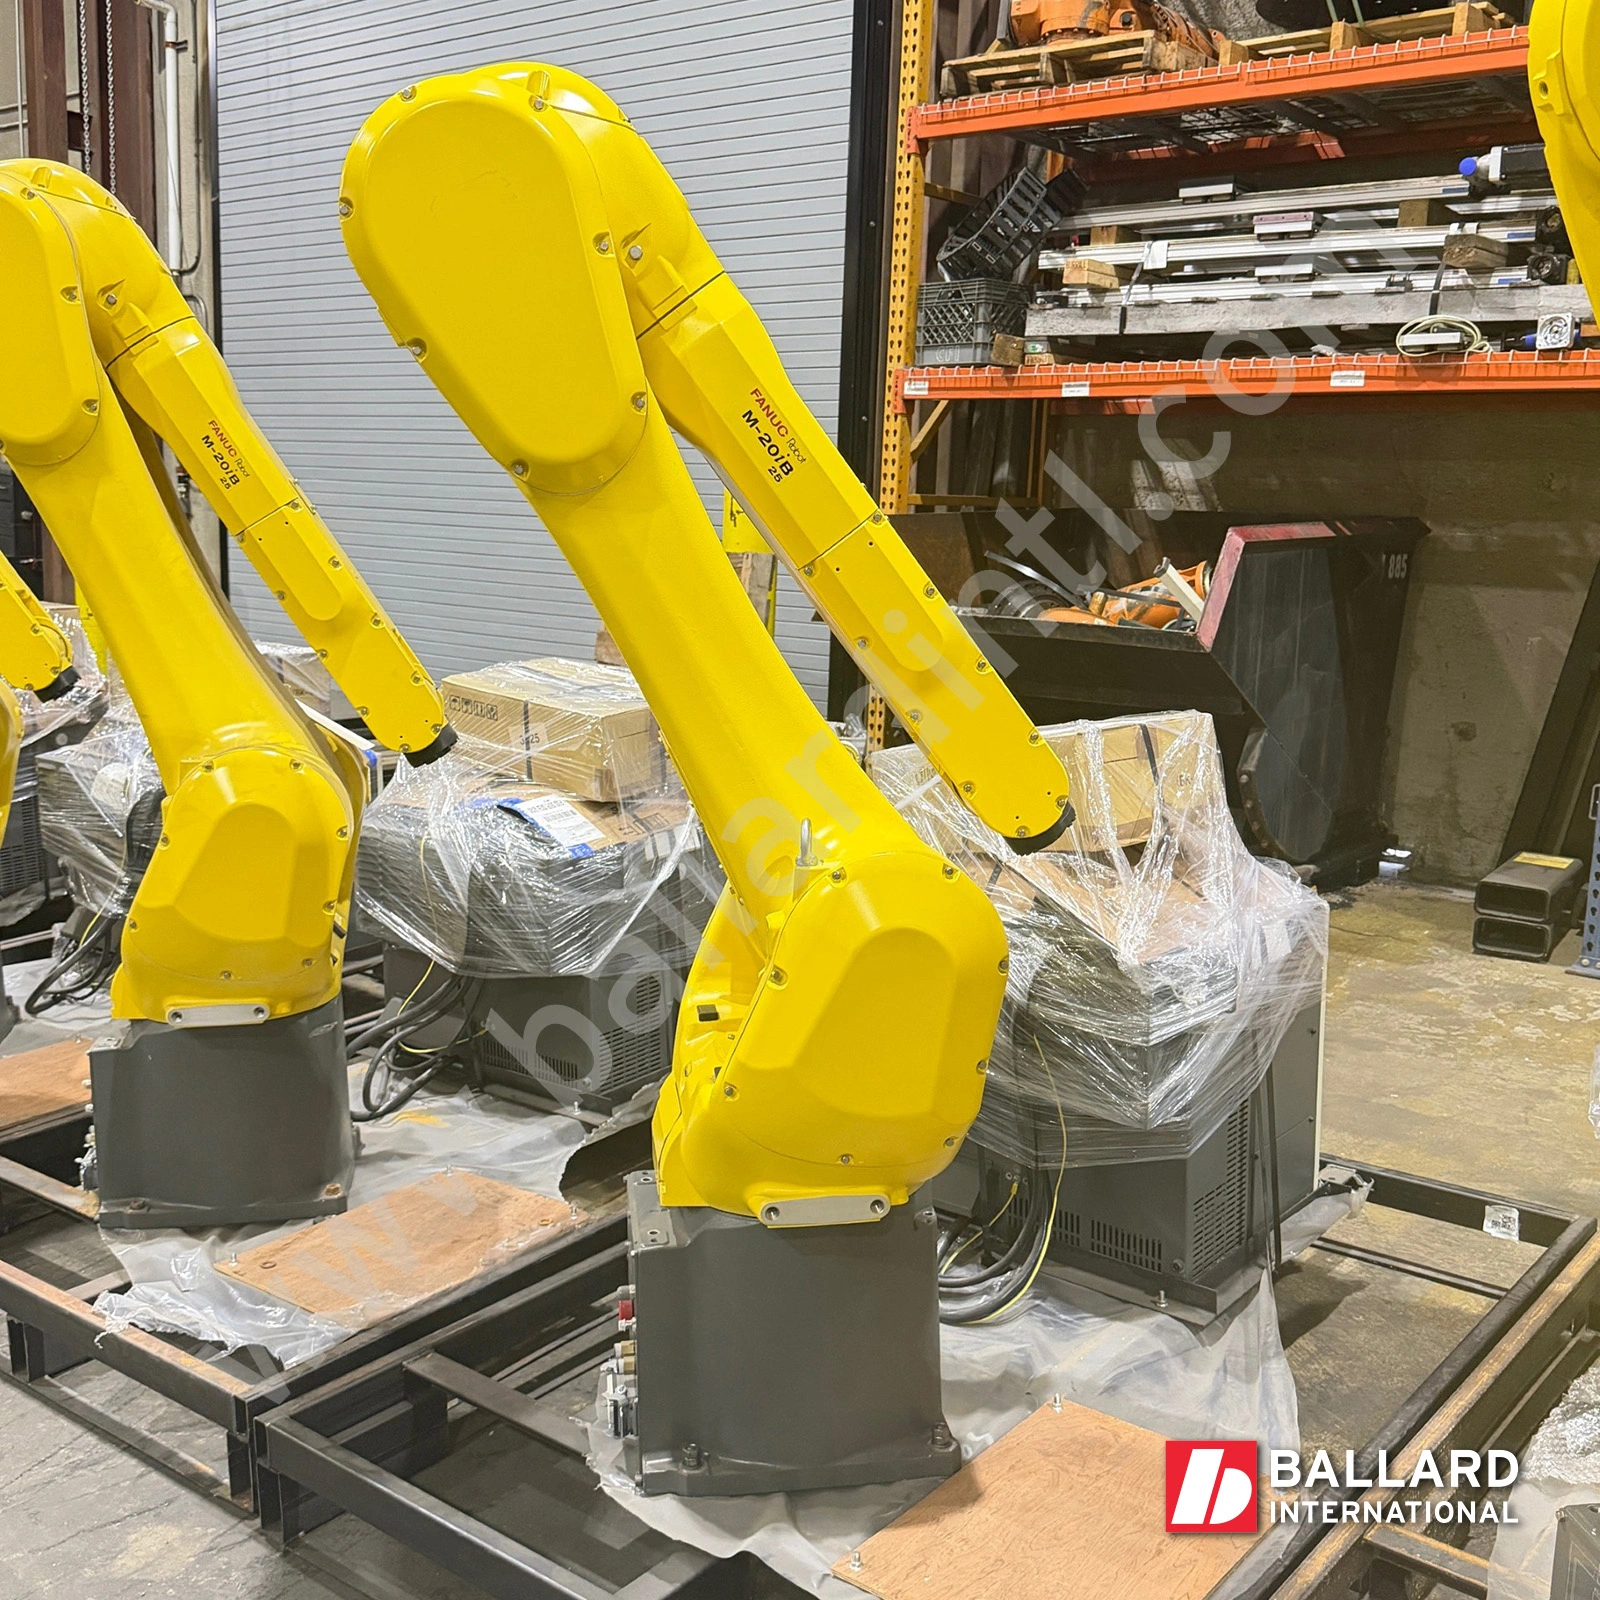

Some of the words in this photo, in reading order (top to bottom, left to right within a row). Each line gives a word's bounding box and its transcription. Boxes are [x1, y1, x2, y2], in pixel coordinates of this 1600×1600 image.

[208, 419, 237, 457] FANUC
[742, 409, 794, 476] M-20iB
[750, 388, 788, 437] FANUC
[786, 437, 806, 463] Robot
[768, 466, 783, 483] 25
